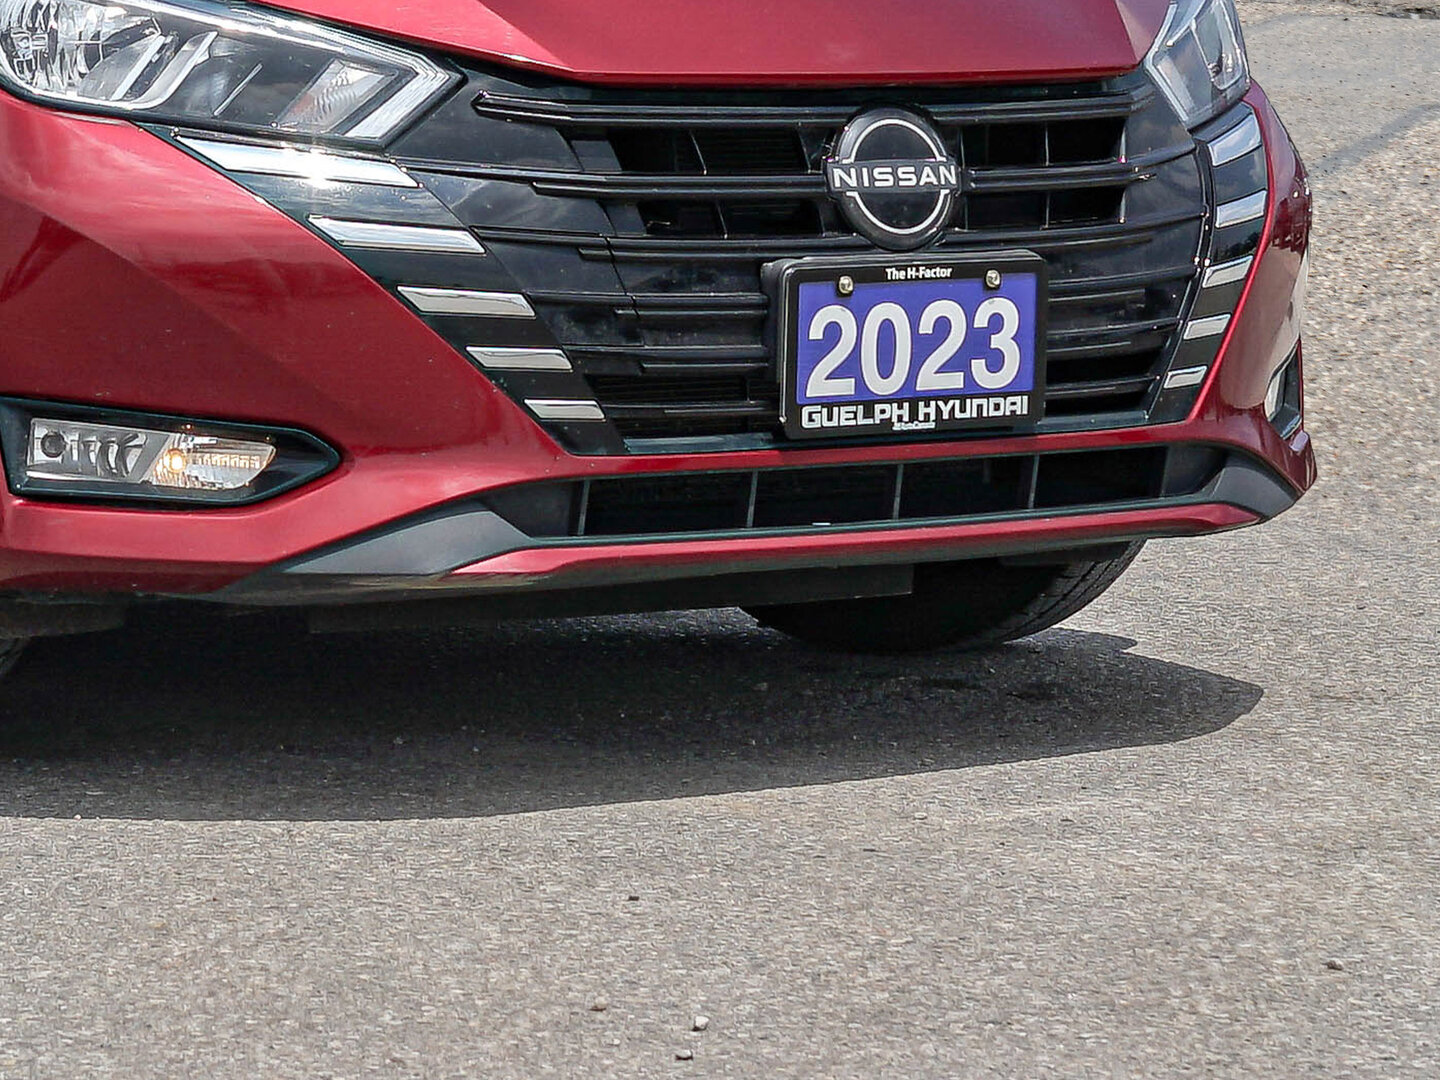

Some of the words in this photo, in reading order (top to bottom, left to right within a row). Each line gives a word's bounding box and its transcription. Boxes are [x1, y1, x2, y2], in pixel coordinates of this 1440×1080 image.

[833, 165, 956, 188] NISSAN
[885, 267, 906, 280] The
[907, 266, 952, 279] H-Factor
[805, 297, 1021, 398] 2023
[801, 402, 909, 428] GUELPH
[918, 395, 1028, 420] HYUNDAI
